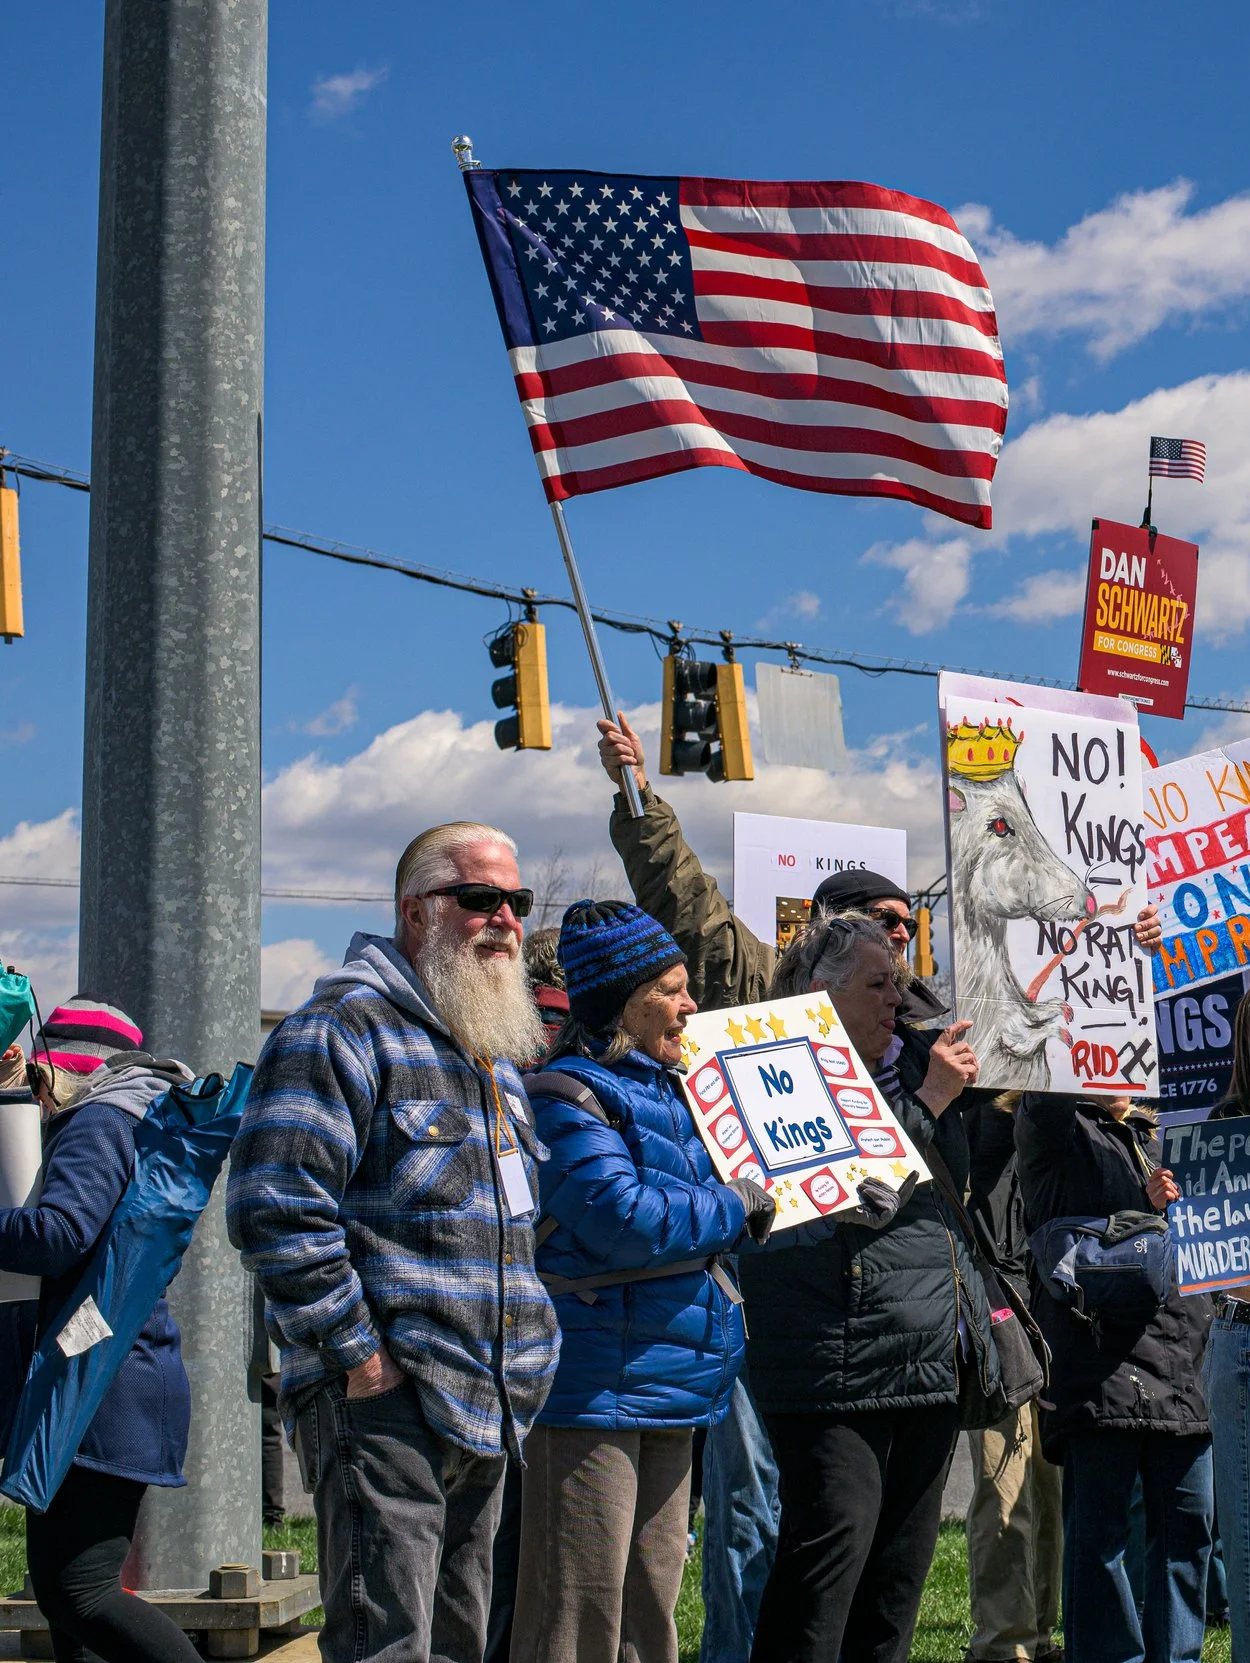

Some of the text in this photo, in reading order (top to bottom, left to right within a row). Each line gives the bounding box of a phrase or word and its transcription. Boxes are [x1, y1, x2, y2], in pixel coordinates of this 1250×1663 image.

[1100, 548, 1146, 588] DAN
[1096, 582, 1188, 644] SCHWARTZ
[1098, 636, 1157, 659] FOR CONGRESS
[1107, 669, 1169, 687] www.schwartzforcongress.com
[1052, 728, 1125, 789] NO!
[1061, 791, 1146, 883] KINGS
[778, 854, 866, 872] NO KINGS
[1030, 914, 1136, 969] NO RAT
[1060, 957, 1148, 1026] KING!
[1154, 994, 1231, 1054] NGS
[758, 1063, 793, 1098] No
[1180, 1078, 1218, 1096] 1776
[764, 1116, 833, 1152] Kings
[1165, 1125, 1225, 1164] The
[1175, 1167, 1206, 1202] id
[1172, 1205, 1221, 1238] the
